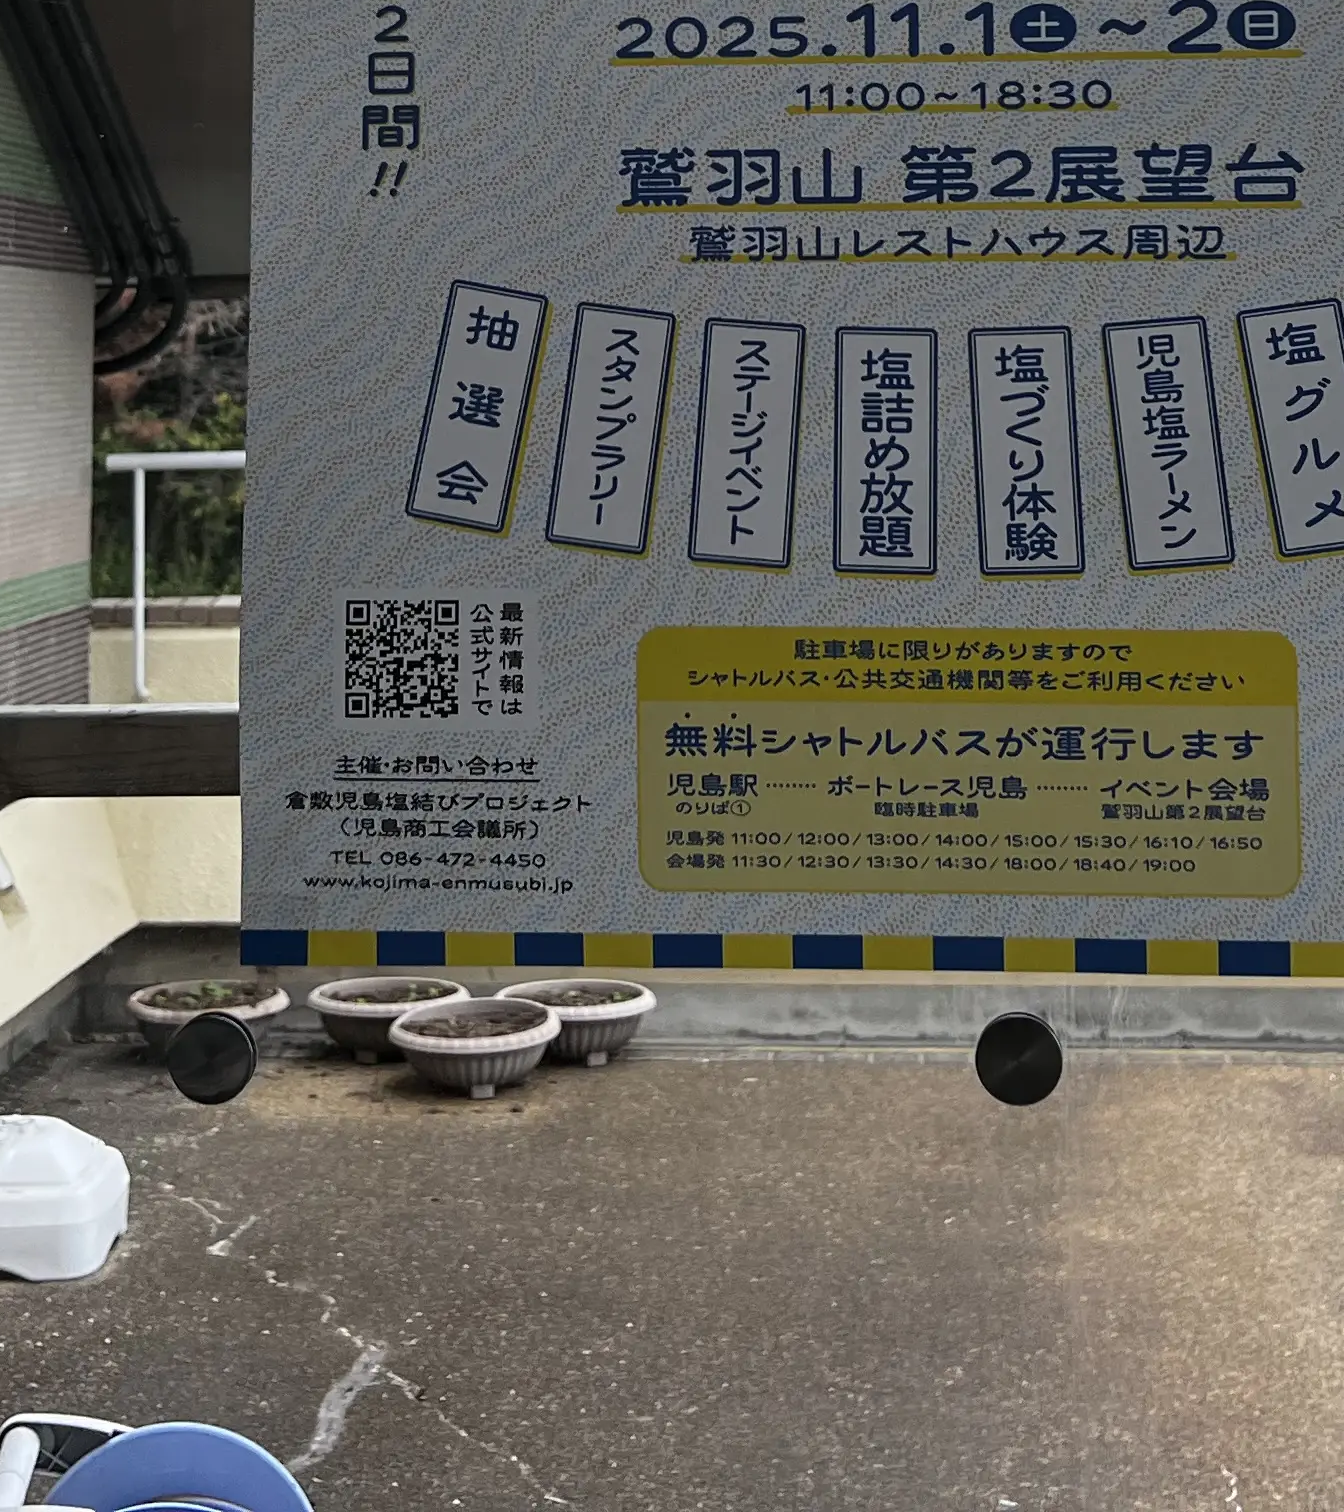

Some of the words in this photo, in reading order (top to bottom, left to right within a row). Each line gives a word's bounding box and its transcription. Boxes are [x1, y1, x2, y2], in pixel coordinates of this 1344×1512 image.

[619, 145, 863, 208] 鷲羽山
[901, 142, 1306, 207] 第2展望台
[689, 223, 1227, 263] 鷲羽山レストハウス周辺
[434, 304, 520, 505] 抽選会
[588, 327, 641, 527] スタンプラリー
[725, 338, 771, 546] ステージイベント
[1135, 333, 1198, 551] 児島塩ラーメン
[858, 346, 916, 560] 塩詰め放題
[993, 343, 1059, 563] 塩づくり体験
[469, 602, 495, 717] 公式サイトで
[499, 601, 525, 716] 最新情報は
[793, 638, 1134, 663] 駐車場に限りがありますので
[664, 721, 1265, 762] 無料シャトルバスが運行します
[285, 790, 592, 813] 倉敷児島塩結びプロジェクト
[666, 772, 759, 798] 児島駅
[827, 774, 1028, 801] ボートレース児島
[1099, 776, 1270, 803] イベント会場
[303, 874, 574, 895] www.kojima-enmusubi.jp
[329, 850, 372, 866] TEL
[379, 851, 546, 868] 086-472-4450
